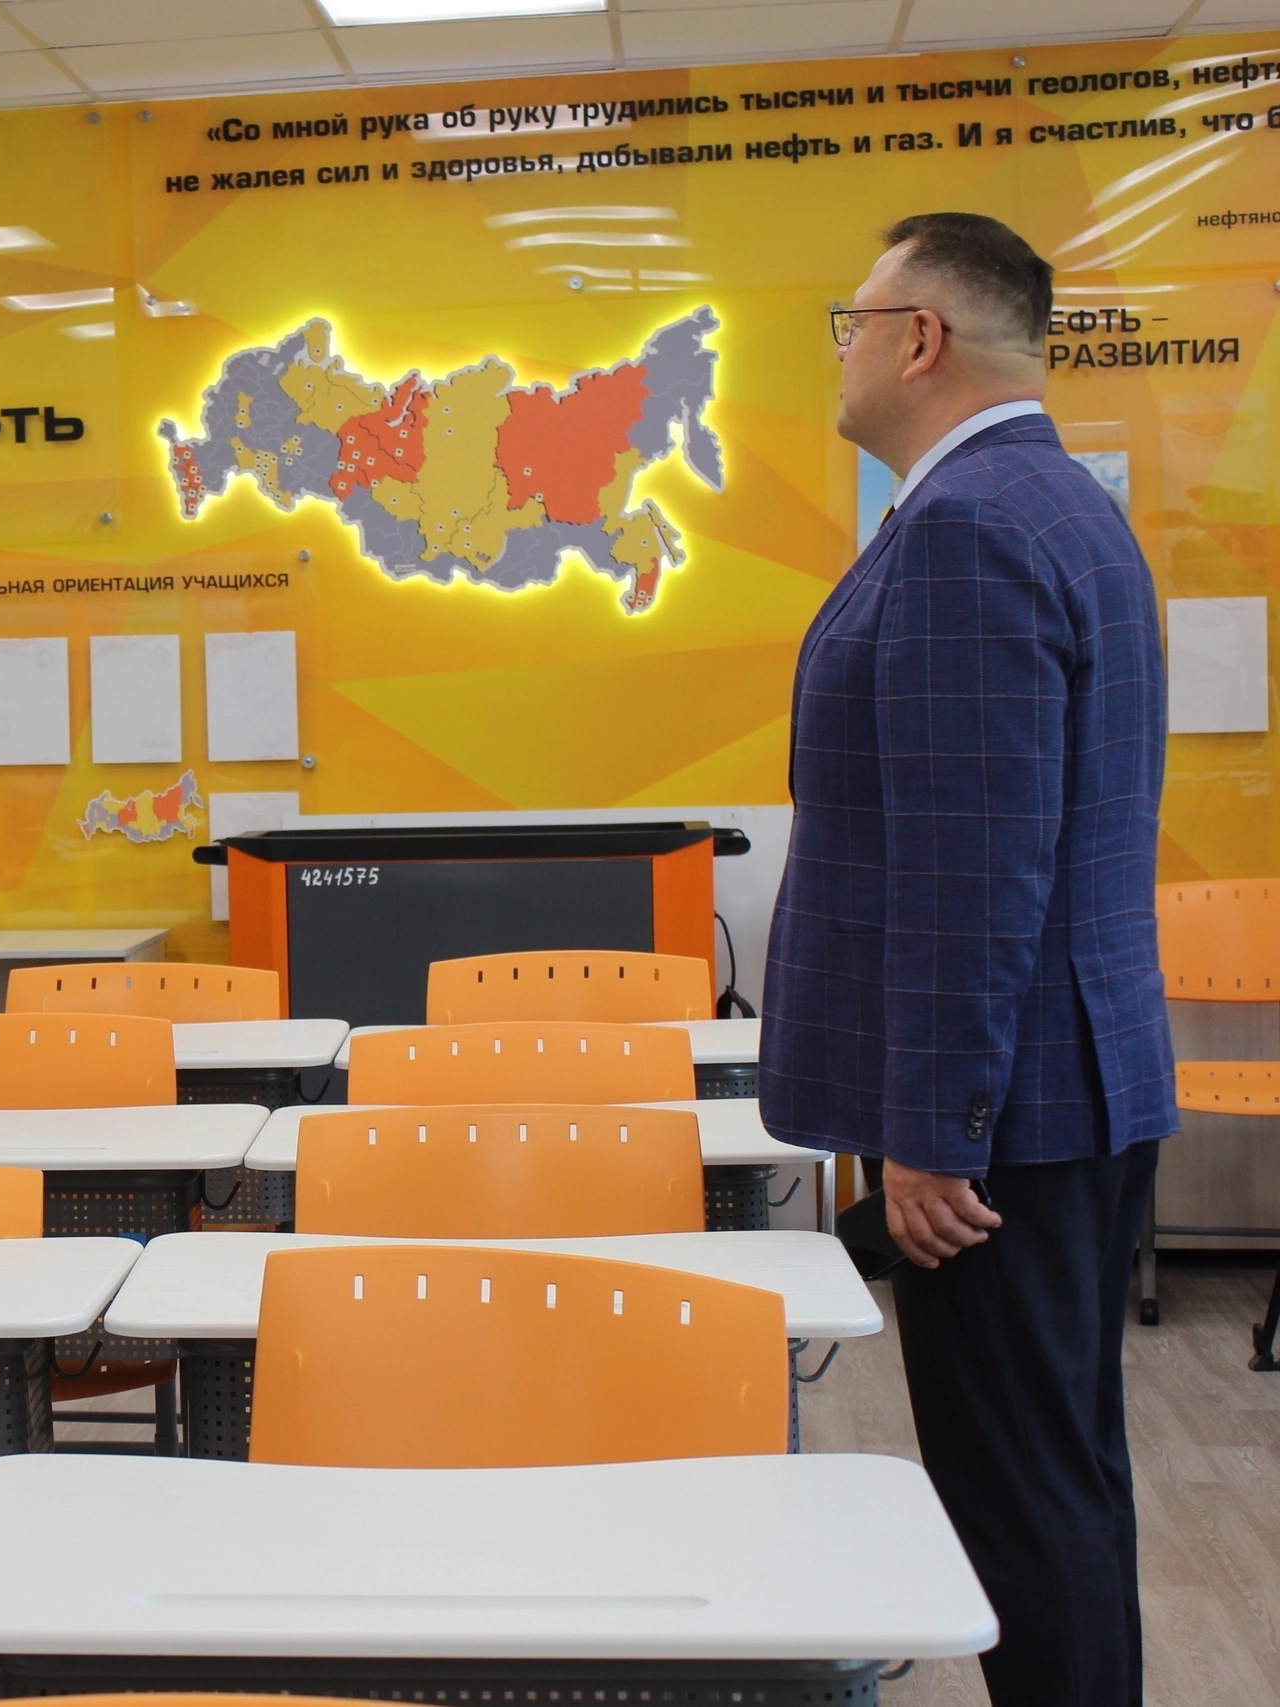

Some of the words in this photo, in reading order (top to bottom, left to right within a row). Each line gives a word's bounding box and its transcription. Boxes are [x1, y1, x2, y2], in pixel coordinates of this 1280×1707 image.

[206, 117, 262, 143] «Со
[271, 112, 349, 140] мной
[360, 112, 429, 141] рука
[442, 103, 476, 129] об
[489, 104, 557, 133] руку
[567, 95, 730, 127] трудились
[739, 86, 855, 111] тысячи
[866, 85, 885, 104] и
[895, 77, 1013, 102] тысячи
[1027, 69, 1180, 96] геологов,
[1192, 56, 1280, 89] нефт
[165, 174, 200, 194] не
[210, 168, 306, 191] жалея
[316, 164, 370, 185] сил
[382, 162, 399, 181] и
[411, 153, 563, 183] здоровья,
[576, 142, 733, 174] добывали
[745, 132, 841, 164] нефть
[853, 135, 872, 154] и
[884, 131, 943, 152] газ.
[957, 121, 983, 148] И
[994, 127, 1013, 146] я
[1028, 117, 1187, 144] счастлив,
[1201, 112, 1254, 133] что
[1047, 308, 1142, 336] ЕФТЬ
[1049, 338, 1240, 370] РАЗВИТИЯ
[52, 575, 174, 593] ОРИЕНТАЦИЯ
[181, 573, 289, 591] УЧАЩИХСЯ
[300, 867, 380, 887] 4241575
